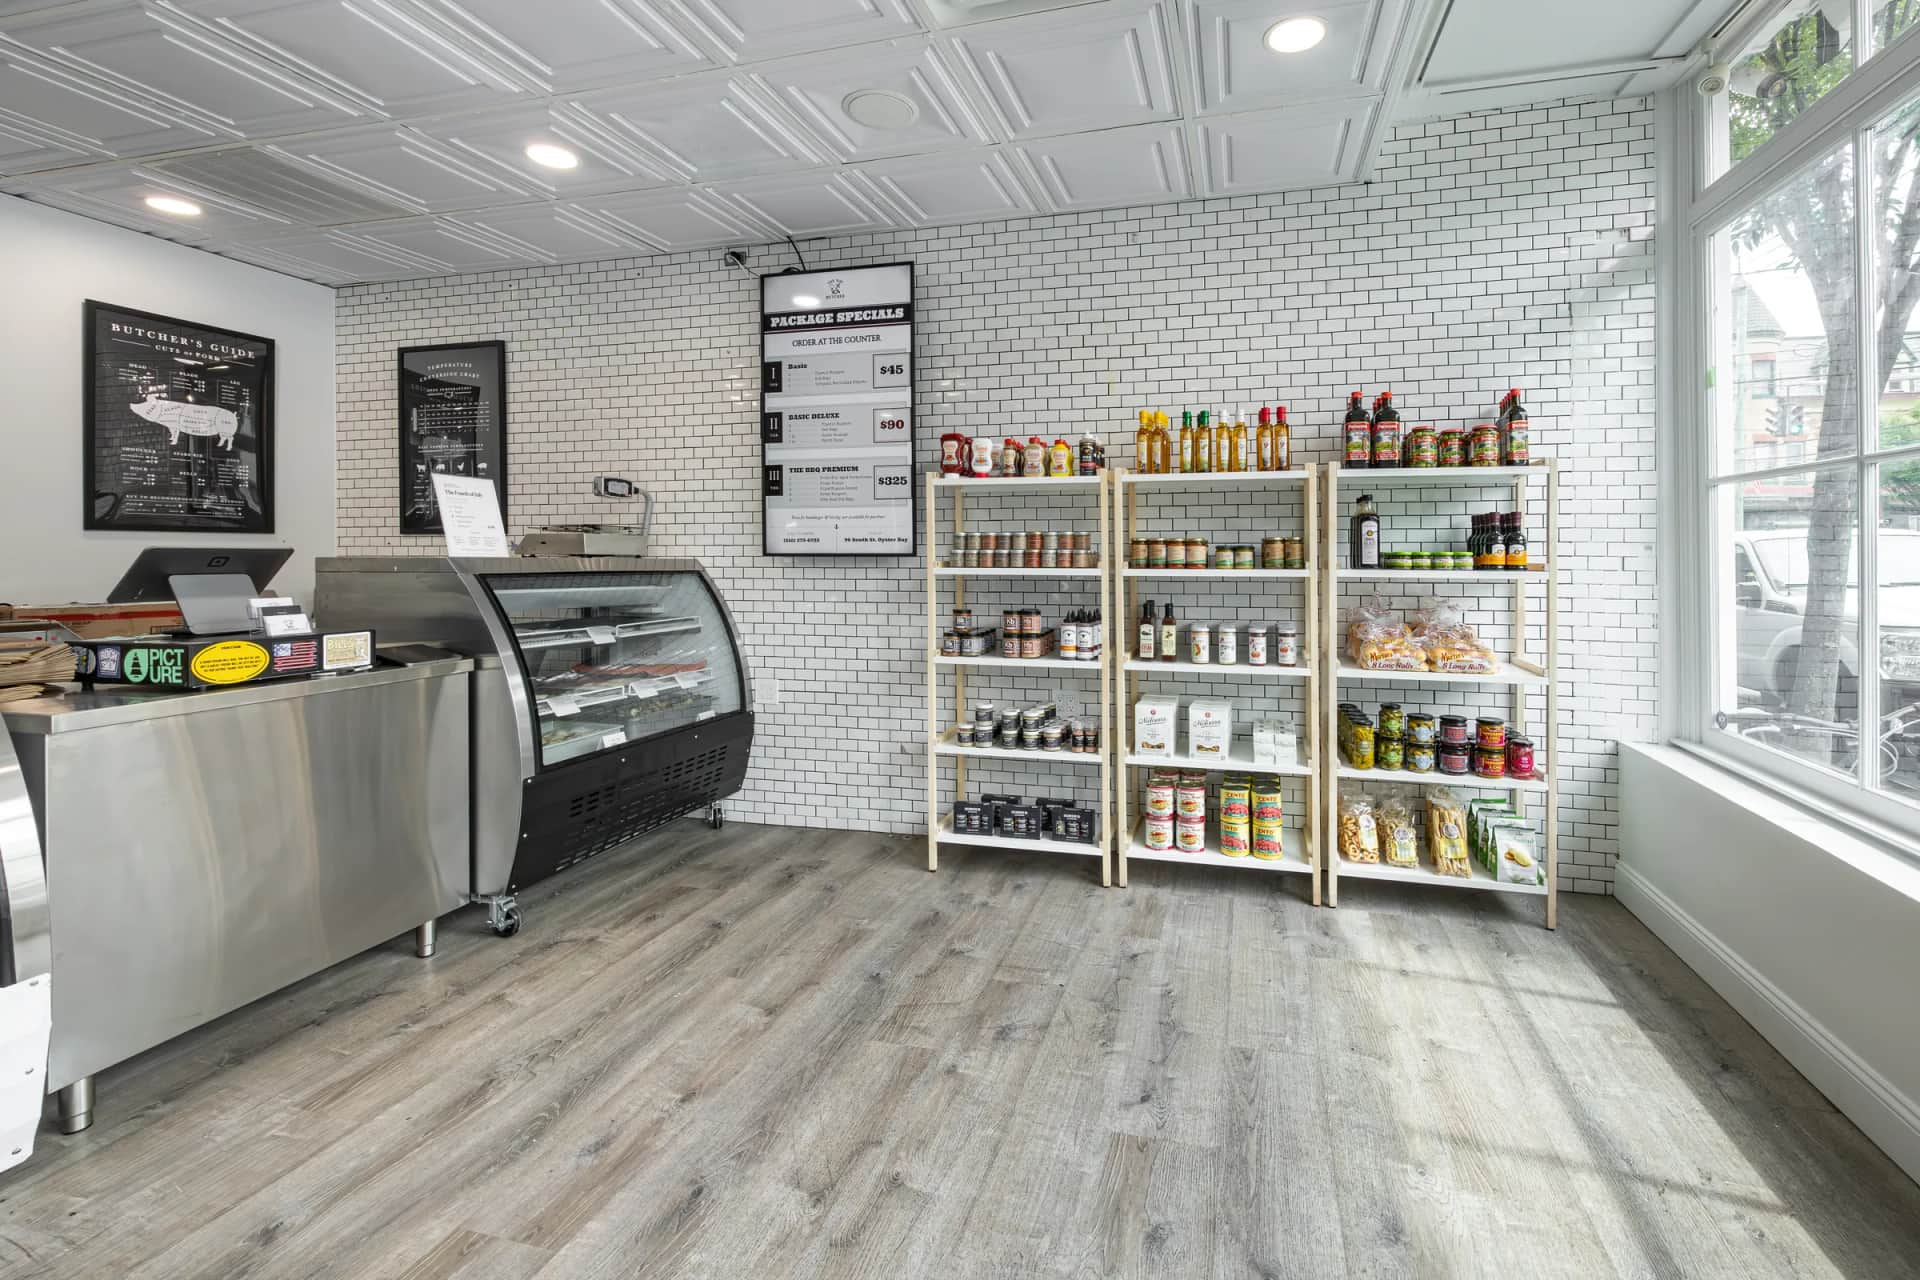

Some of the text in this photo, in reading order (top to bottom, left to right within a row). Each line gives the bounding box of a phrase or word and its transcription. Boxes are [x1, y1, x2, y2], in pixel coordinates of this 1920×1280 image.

[770, 308, 904, 327] PACKAGE SPECIALS
[111, 323, 256, 359] BUTCHER'S GUIDE
[792, 334, 881, 347] ORDER AT THE COUNTER
[155, 344, 180, 354] CUTS
[879, 364, 904, 375] $45
[811, 412, 840, 420] DELUXE
[879, 419, 905, 430] $90
[822, 465, 859, 473] PREMIUM
[878, 476, 908, 486] $325
[149, 648, 184, 666] PICT
[149, 666, 183, 683] URE
